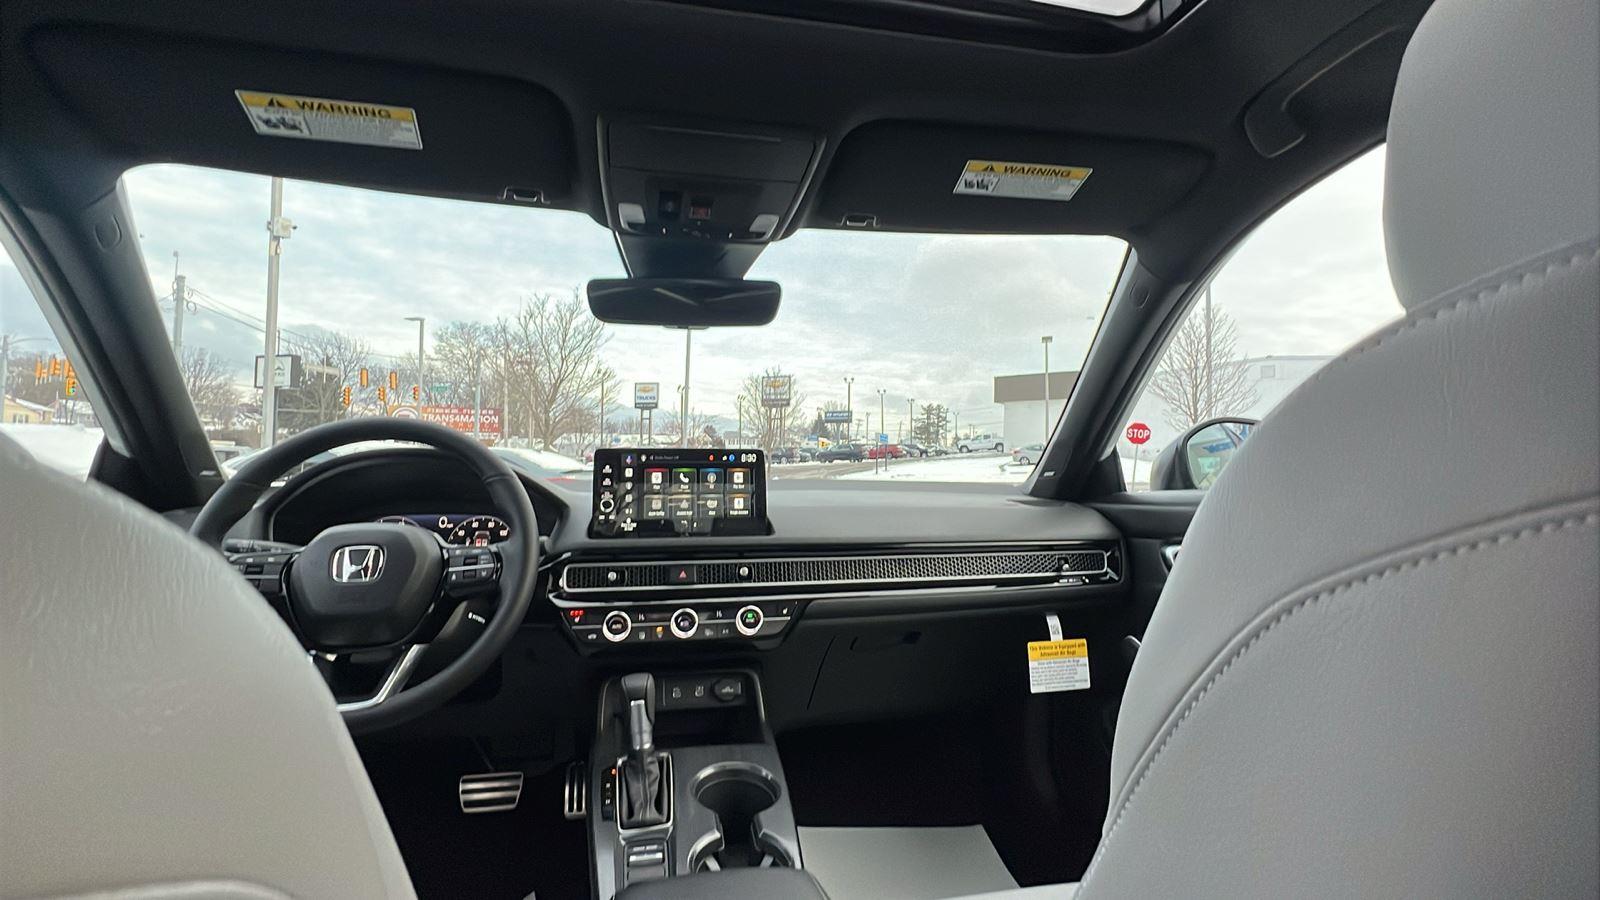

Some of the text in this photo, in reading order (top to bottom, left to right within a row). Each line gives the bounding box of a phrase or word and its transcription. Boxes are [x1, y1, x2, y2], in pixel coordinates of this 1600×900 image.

[295, 101, 391, 118] WARNING
[1004, 165, 1071, 177] WARNING
[423, 414, 499, 423] TRANS4MAION
[1127, 428, 1150, 438] STOP
